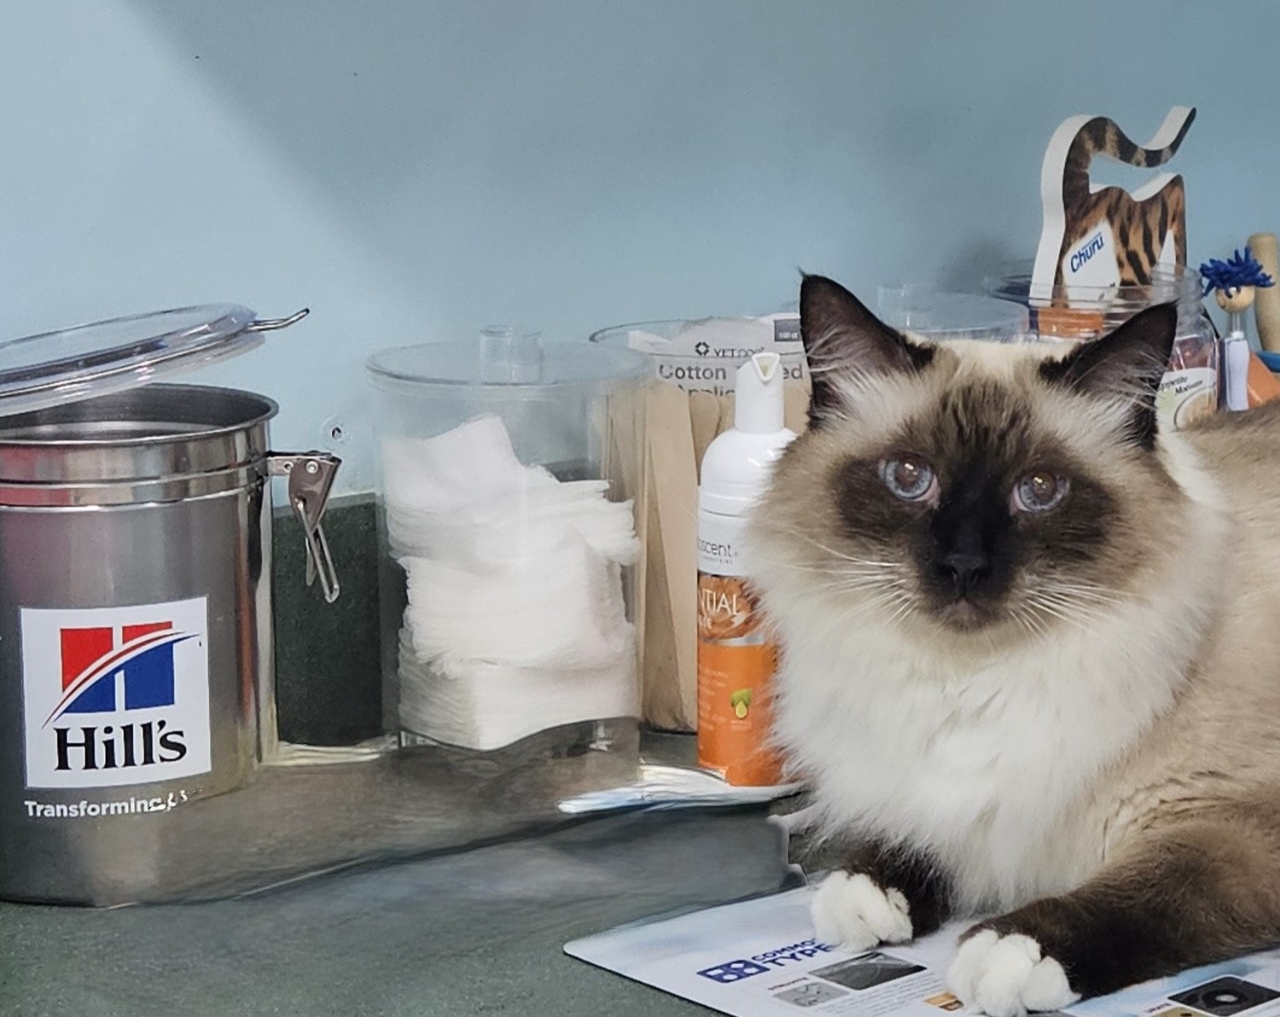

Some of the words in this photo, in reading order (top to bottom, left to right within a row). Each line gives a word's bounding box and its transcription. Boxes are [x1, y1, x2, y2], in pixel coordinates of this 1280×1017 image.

[1070, 236, 1105, 273] Churu
[659, 364, 727, 380] Cotton
[54, 720, 187, 771] Hill's
[751, 938, 816, 961] COMMO
